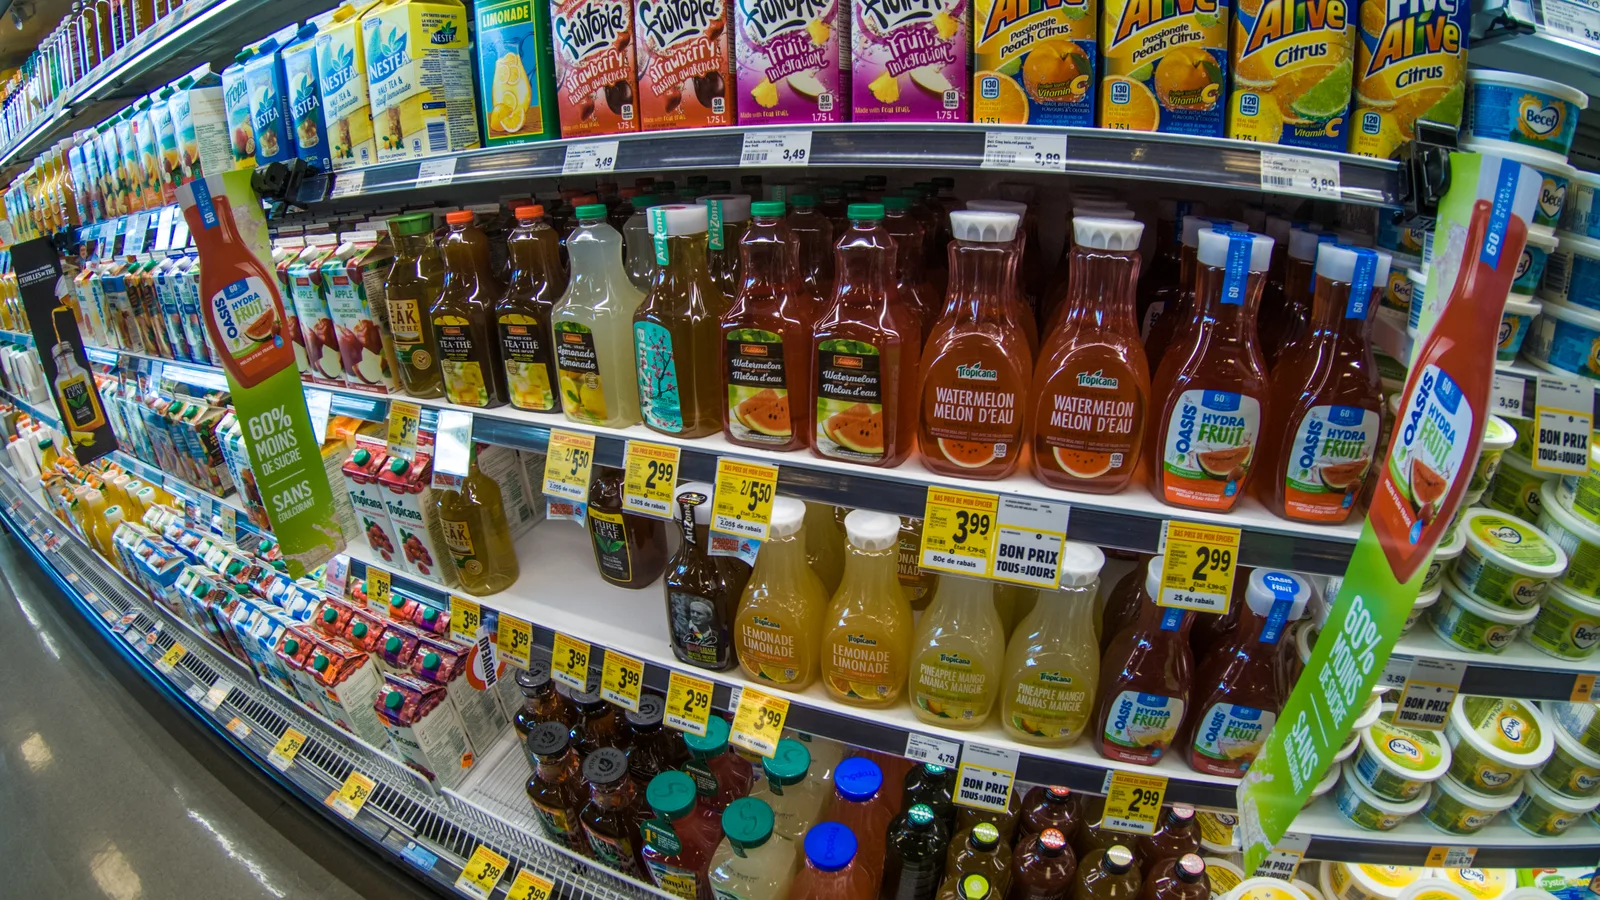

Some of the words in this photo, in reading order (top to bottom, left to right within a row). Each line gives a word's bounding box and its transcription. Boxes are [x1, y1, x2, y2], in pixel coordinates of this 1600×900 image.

[483, 5, 529, 28] LIMONADE
[1011, 17, 1057, 42] Passionate
[1142, 22, 1189, 47] Passionate
[1001, 33, 1035, 58] Peach
[1132, 38, 1167, 63] Peach
[1364, 16, 1460, 78] Alive
[1274, 42, 1327, 68] Citrus
[369, 54, 412, 82] NESTEA
[1395, 65, 1443, 88] Citrus
[325, 66, 359, 97] NESTEA
[984, 80, 997, 88] 130
[1038, 87, 1071, 98] Vitamin
[1070, 74, 1090, 95] C
[1114, 85, 1127, 94] 130
[713, 98, 723, 107] 90
[820, 95, 831, 104] 90
[946, 92, 956, 101] 90
[1168, 96, 1203, 105] Vitamin
[1201, 84, 1220, 103] C
[1243, 96, 1256, 105] 120
[706, 115, 721, 125] 1.75
[811, 113, 826, 122] 1.75
[936, 111, 951, 120] 1.75
[1365, 115, 1378, 124] 120
[1526, 109, 1556, 127] Becel
[1294, 128, 1326, 138] Vitamin
[1325, 118, 1341, 138] C
[595, 157, 613, 168] 3,49
[783, 149, 805, 161] 3,49
[1034, 152, 1061, 167] 3,89
[1310, 176, 1335, 192] 3,89
[231, 292, 260, 311] HYDRA
[335, 289, 353, 299] APPLE
[214, 298, 238, 339] OASIS
[558, 345, 595, 359] Lemonade
[559, 356, 596, 370] Limonade
[731, 358, 781, 370] Watermelon
[957, 364, 996, 379] Tropicana
[732, 371, 759, 382] Melon
[760, 372, 782, 384] d'eau
[822, 369, 877, 384] Watermelon
[1076, 372, 1118, 387] Tropicana
[822, 383, 851, 396] Melon
[852, 385, 877, 398] d'eau
[936, 386, 1015, 409] WATERMELON
[1053, 394, 1134, 417] WATERMELON
[1403, 371, 1434, 446] OASIS
[1499, 396, 1520, 409] 3,59
[934, 402, 973, 422] MELON
[979, 406, 1014, 424] D'EAU
[1050, 410, 1090, 431] MELON
[1096, 417, 1132, 434] D'EAU
[1201, 412, 1246, 427] HYDRA
[248, 404, 293, 441] 60%
[1175, 404, 1197, 454] OASIS
[1428, 402, 1456, 446] HYDRA
[1326, 428, 1366, 441] HYDRA
[1540, 428, 1561, 446] BON
[1563, 432, 1588, 450] PRIX
[254, 427, 298, 462] MOINS
[1299, 420, 1324, 468] OASIS
[261, 462, 275, 477] DE
[275, 448, 302, 471] SUCRE
[1538, 448, 1558, 462] TOUS
[1562, 452, 1587, 466] JOURS
[272, 479, 313, 512] SANS
[350, 490, 382, 509] Tropicana
[933, 494, 943, 503] BAS
[942, 496, 954, 505] PRIX
[961, 499, 973, 508] MON
[277, 496, 315, 524] ÉDULCORANT
[386, 500, 422, 520] Tropicana
[594, 519, 618, 532] PURE
[595, 527, 619, 540] LEAF
[745, 524, 762, 534] rabais
[1173, 528, 1182, 538] BAS
[1183, 530, 1195, 540] PRIX
[1203, 532, 1213, 542] MON
[955, 558, 977, 569] rabais
[998, 543, 1024, 560] BON
[1027, 548, 1060, 566] PRIX
[996, 560, 1021, 574] TOUS
[1025, 566, 1056, 581] JOURS
[1266, 575, 1293, 585] OASIS
[1194, 596, 1215, 606] rabais
[752, 616, 781, 629] Tropicana
[742, 624, 794, 647] LEMONADE
[847, 634, 877, 647] Tropicana
[1343, 594, 1383, 676] 60%
[743, 635, 794, 658] LIMONADE
[833, 643, 890, 668] LEMONADE
[478, 635, 497, 687] NOUVEAU
[833, 655, 888, 679] LIMONADE
[940, 653, 971, 667] Tropicana
[1329, 631, 1363, 706] MOINS
[920, 663, 957, 683] PINEAPPLE
[958, 670, 985, 690] MANGO
[1039, 672, 1072, 685] Tropicana
[1386, 674, 1406, 684] 3,59
[918, 674, 949, 691] ANANAS
[950, 681, 983, 700] MANGUE
[1017, 683, 1055, 704] PINEAPPLE
[1058, 690, 1085, 708] MANGO
[1318, 661, 1331, 684] DE
[1325, 682, 1348, 730] SUCRE
[1015, 694, 1047, 715] ANANAS
[1048, 700, 1081, 718] MANGUE
[1136, 707, 1171, 717] HYDRA
[1404, 696, 1424, 710] BON
[1426, 699, 1451, 713] PRIX
[1115, 699, 1133, 730] OASIS
[1399, 709, 1419, 721] TOUS
[1420, 713, 1445, 725] JOURS
[1206, 711, 1226, 741] OASIS
[1228, 719, 1262, 731] HYDRA
[1292, 709, 1318, 782] SANS
[1394, 741, 1418, 758] Becel
[937, 752, 955, 764] 4,79
[962, 777, 983, 792] BON
[984, 779, 1010, 796] PRIX
[960, 790, 979, 802] TOUS
[983, 794, 1007, 807] JOURS
[1273, 861, 1295, 873] PRIX
